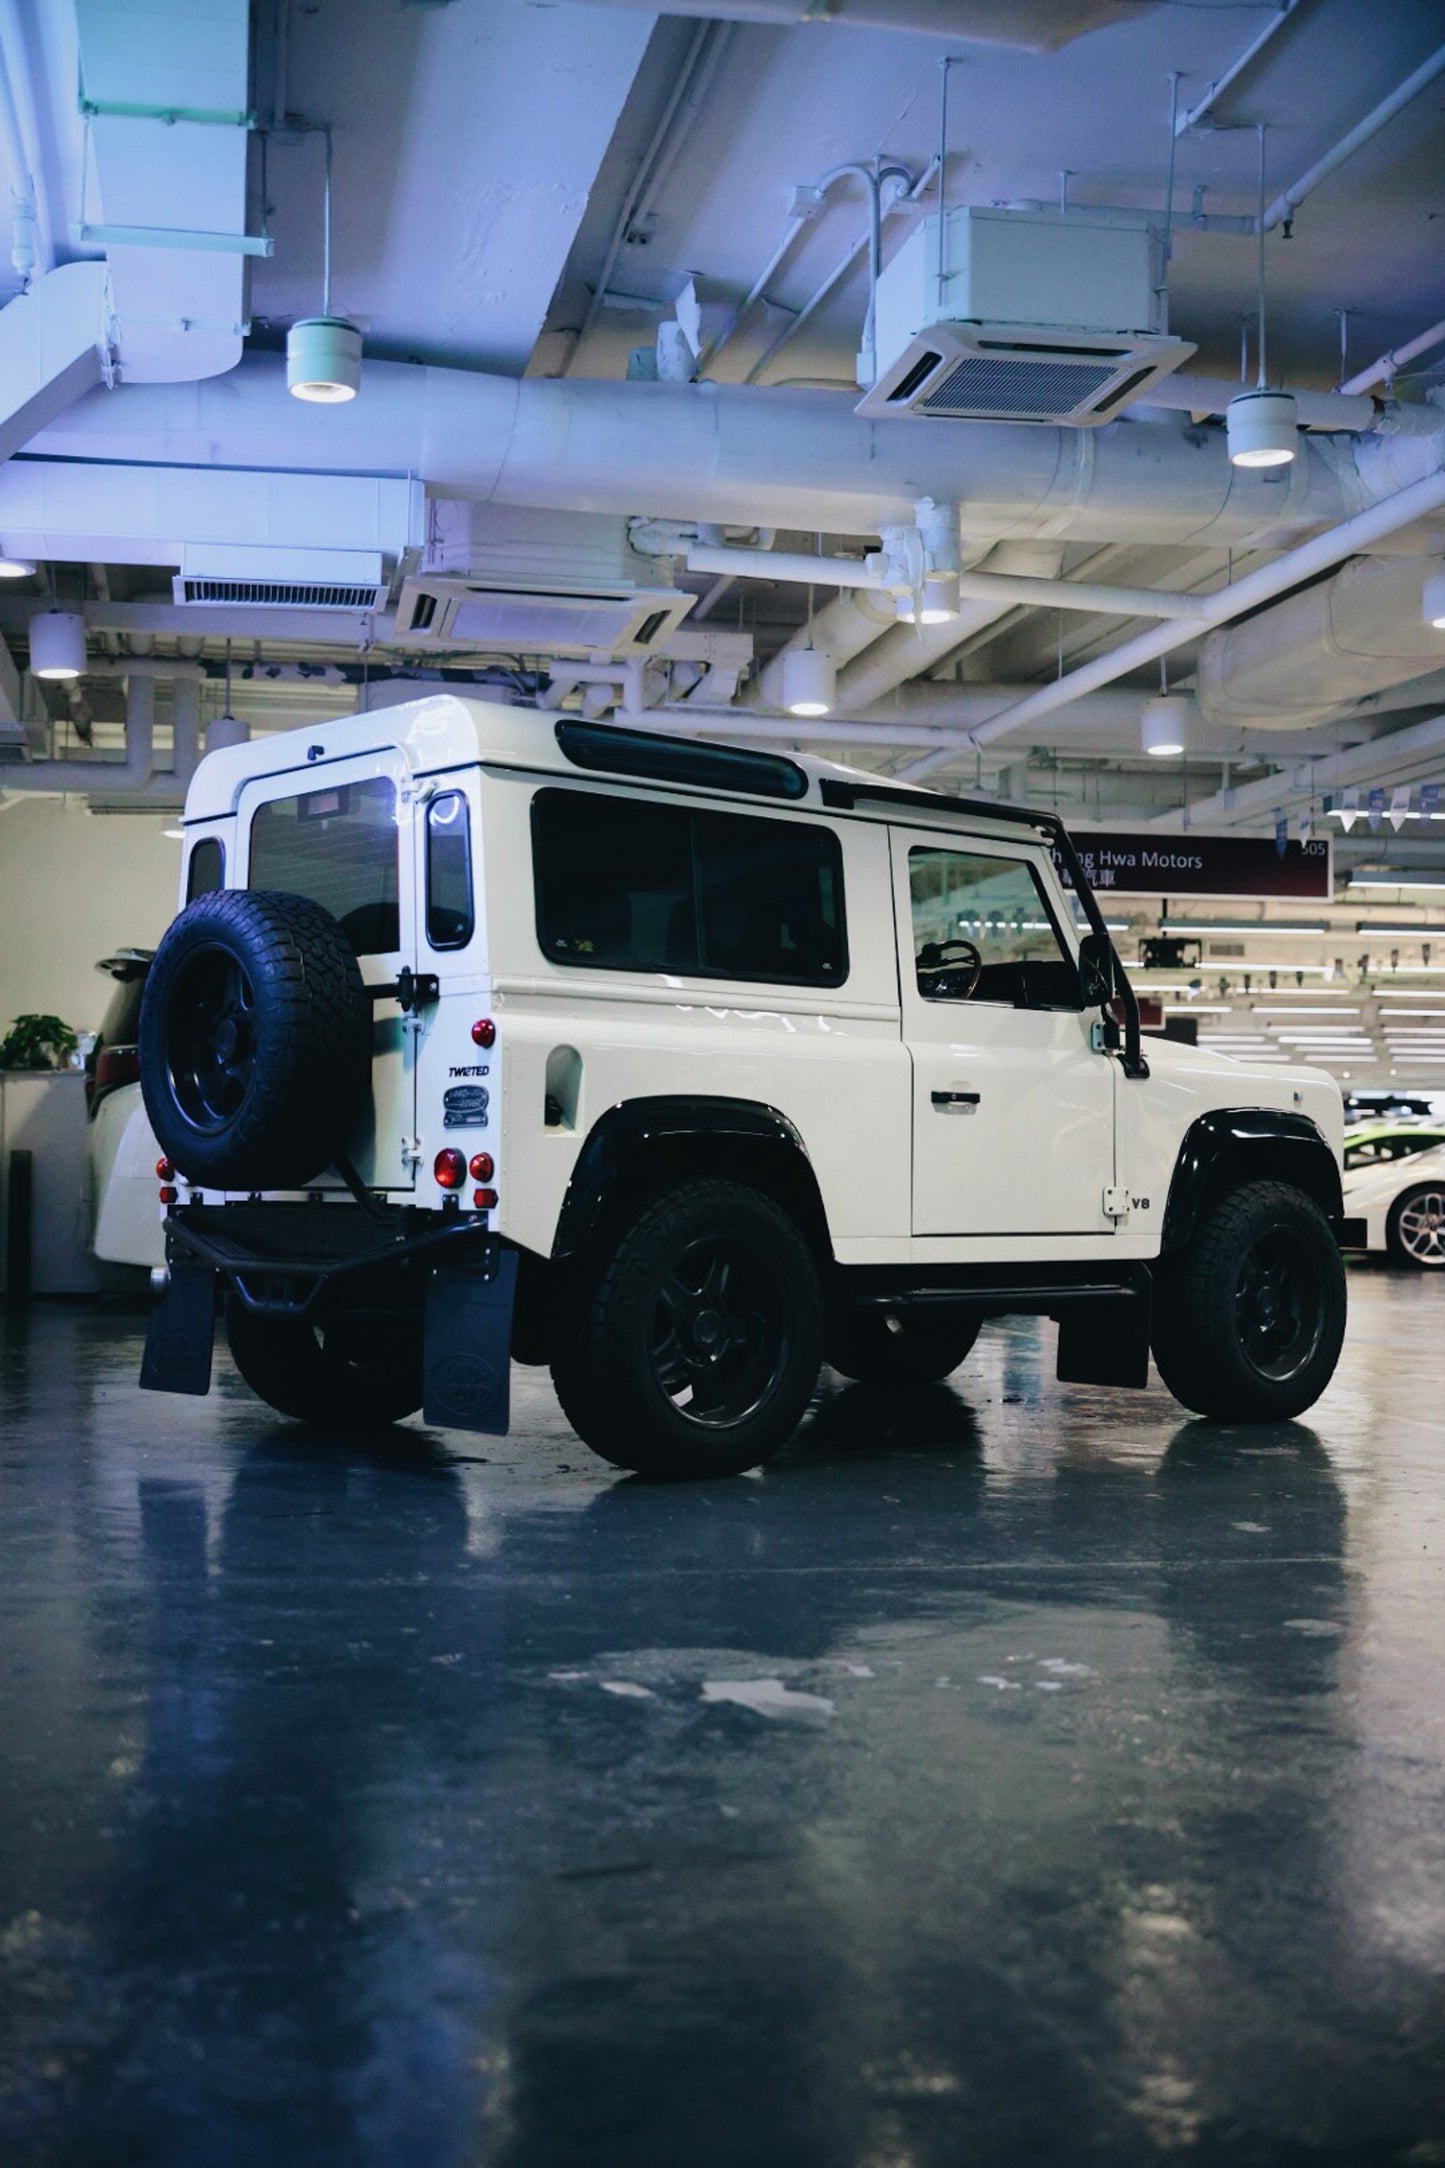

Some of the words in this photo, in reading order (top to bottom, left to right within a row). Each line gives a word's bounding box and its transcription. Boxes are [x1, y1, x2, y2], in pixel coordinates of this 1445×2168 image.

[1099, 850, 1136, 866] Hwa
[1141, 851, 1203, 869] Motors
[449, 1065, 490, 1078] TWISTED
[1131, 1198, 1150, 1210] V8
